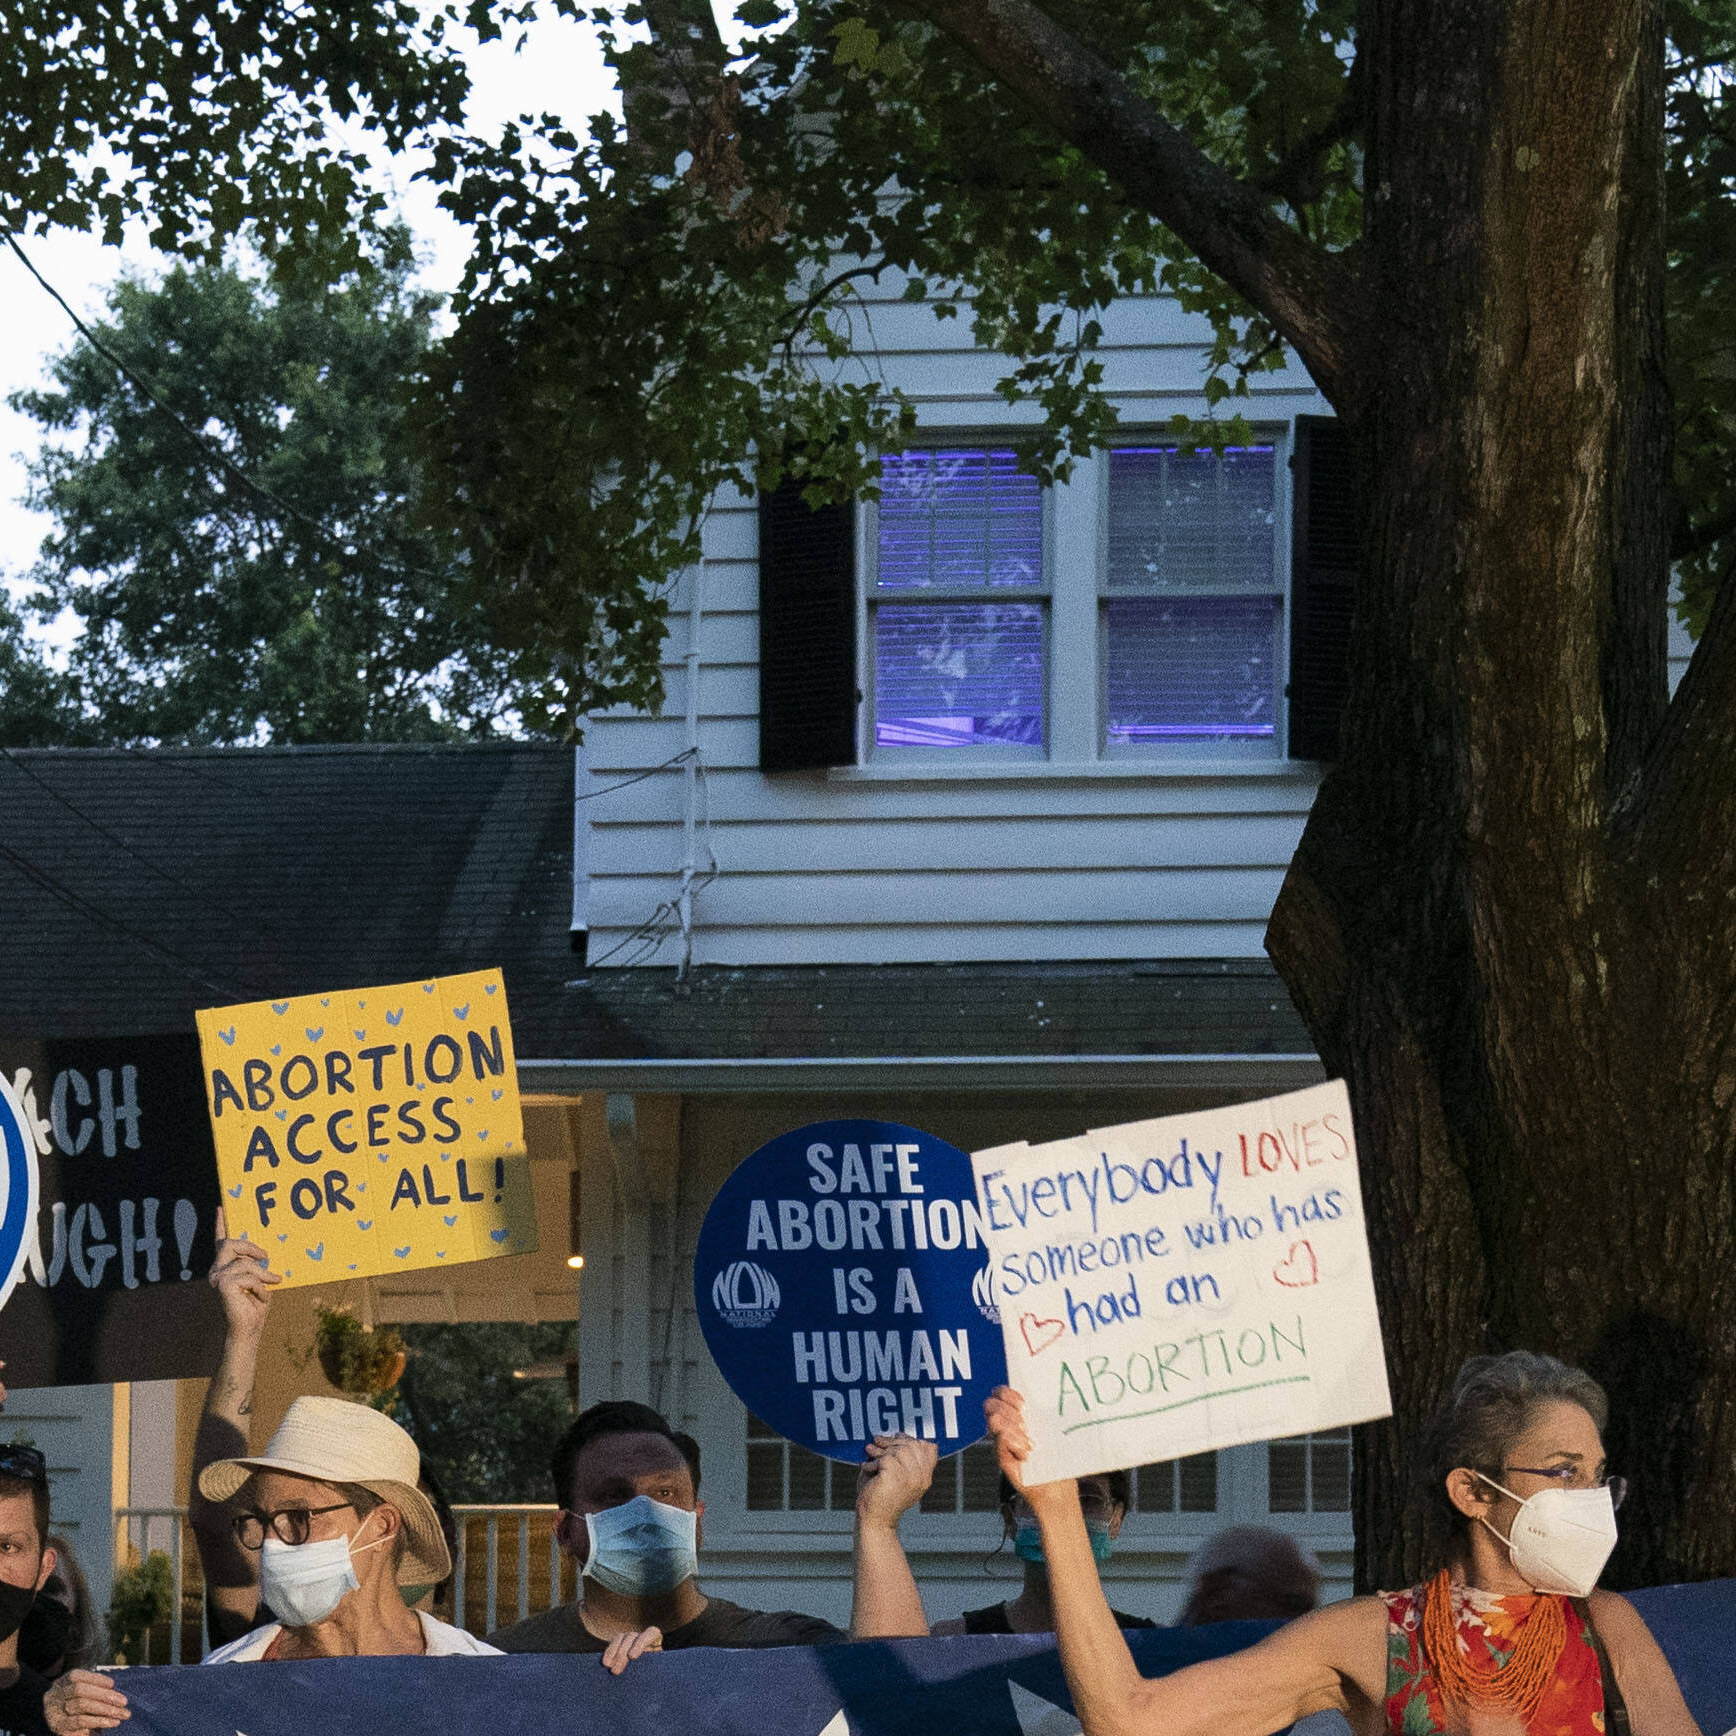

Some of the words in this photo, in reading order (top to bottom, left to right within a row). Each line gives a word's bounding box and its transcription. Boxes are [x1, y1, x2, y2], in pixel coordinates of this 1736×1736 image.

[210, 1023, 505, 1120] ABORTION
[242, 1094, 462, 1174] ACCESS
[256, 1165, 378, 1228] FOR
[390, 1157, 505, 1210] ALL!
[806, 1142, 925, 1196] SAFE
[980, 1136, 1224, 1232] Everybody
[1237, 1113, 1351, 1180] LOVES
[745, 1198, 992, 1253] ABORTION
[1000, 1226, 1173, 1299] someone
[1185, 1204, 1266, 1249] who
[1272, 1186, 1346, 1243] has
[711, 1261, 781, 1310] NOW
[833, 1267, 875, 1315] IS
[893, 1267, 924, 1314] A
[1066, 1279, 1142, 1337] had
[1166, 1269, 1222, 1308] an
[792, 1327, 973, 1384] HUMAN
[1056, 1313, 1308, 1418] ABORTION
[813, 1385, 964, 1442] RIGHT
